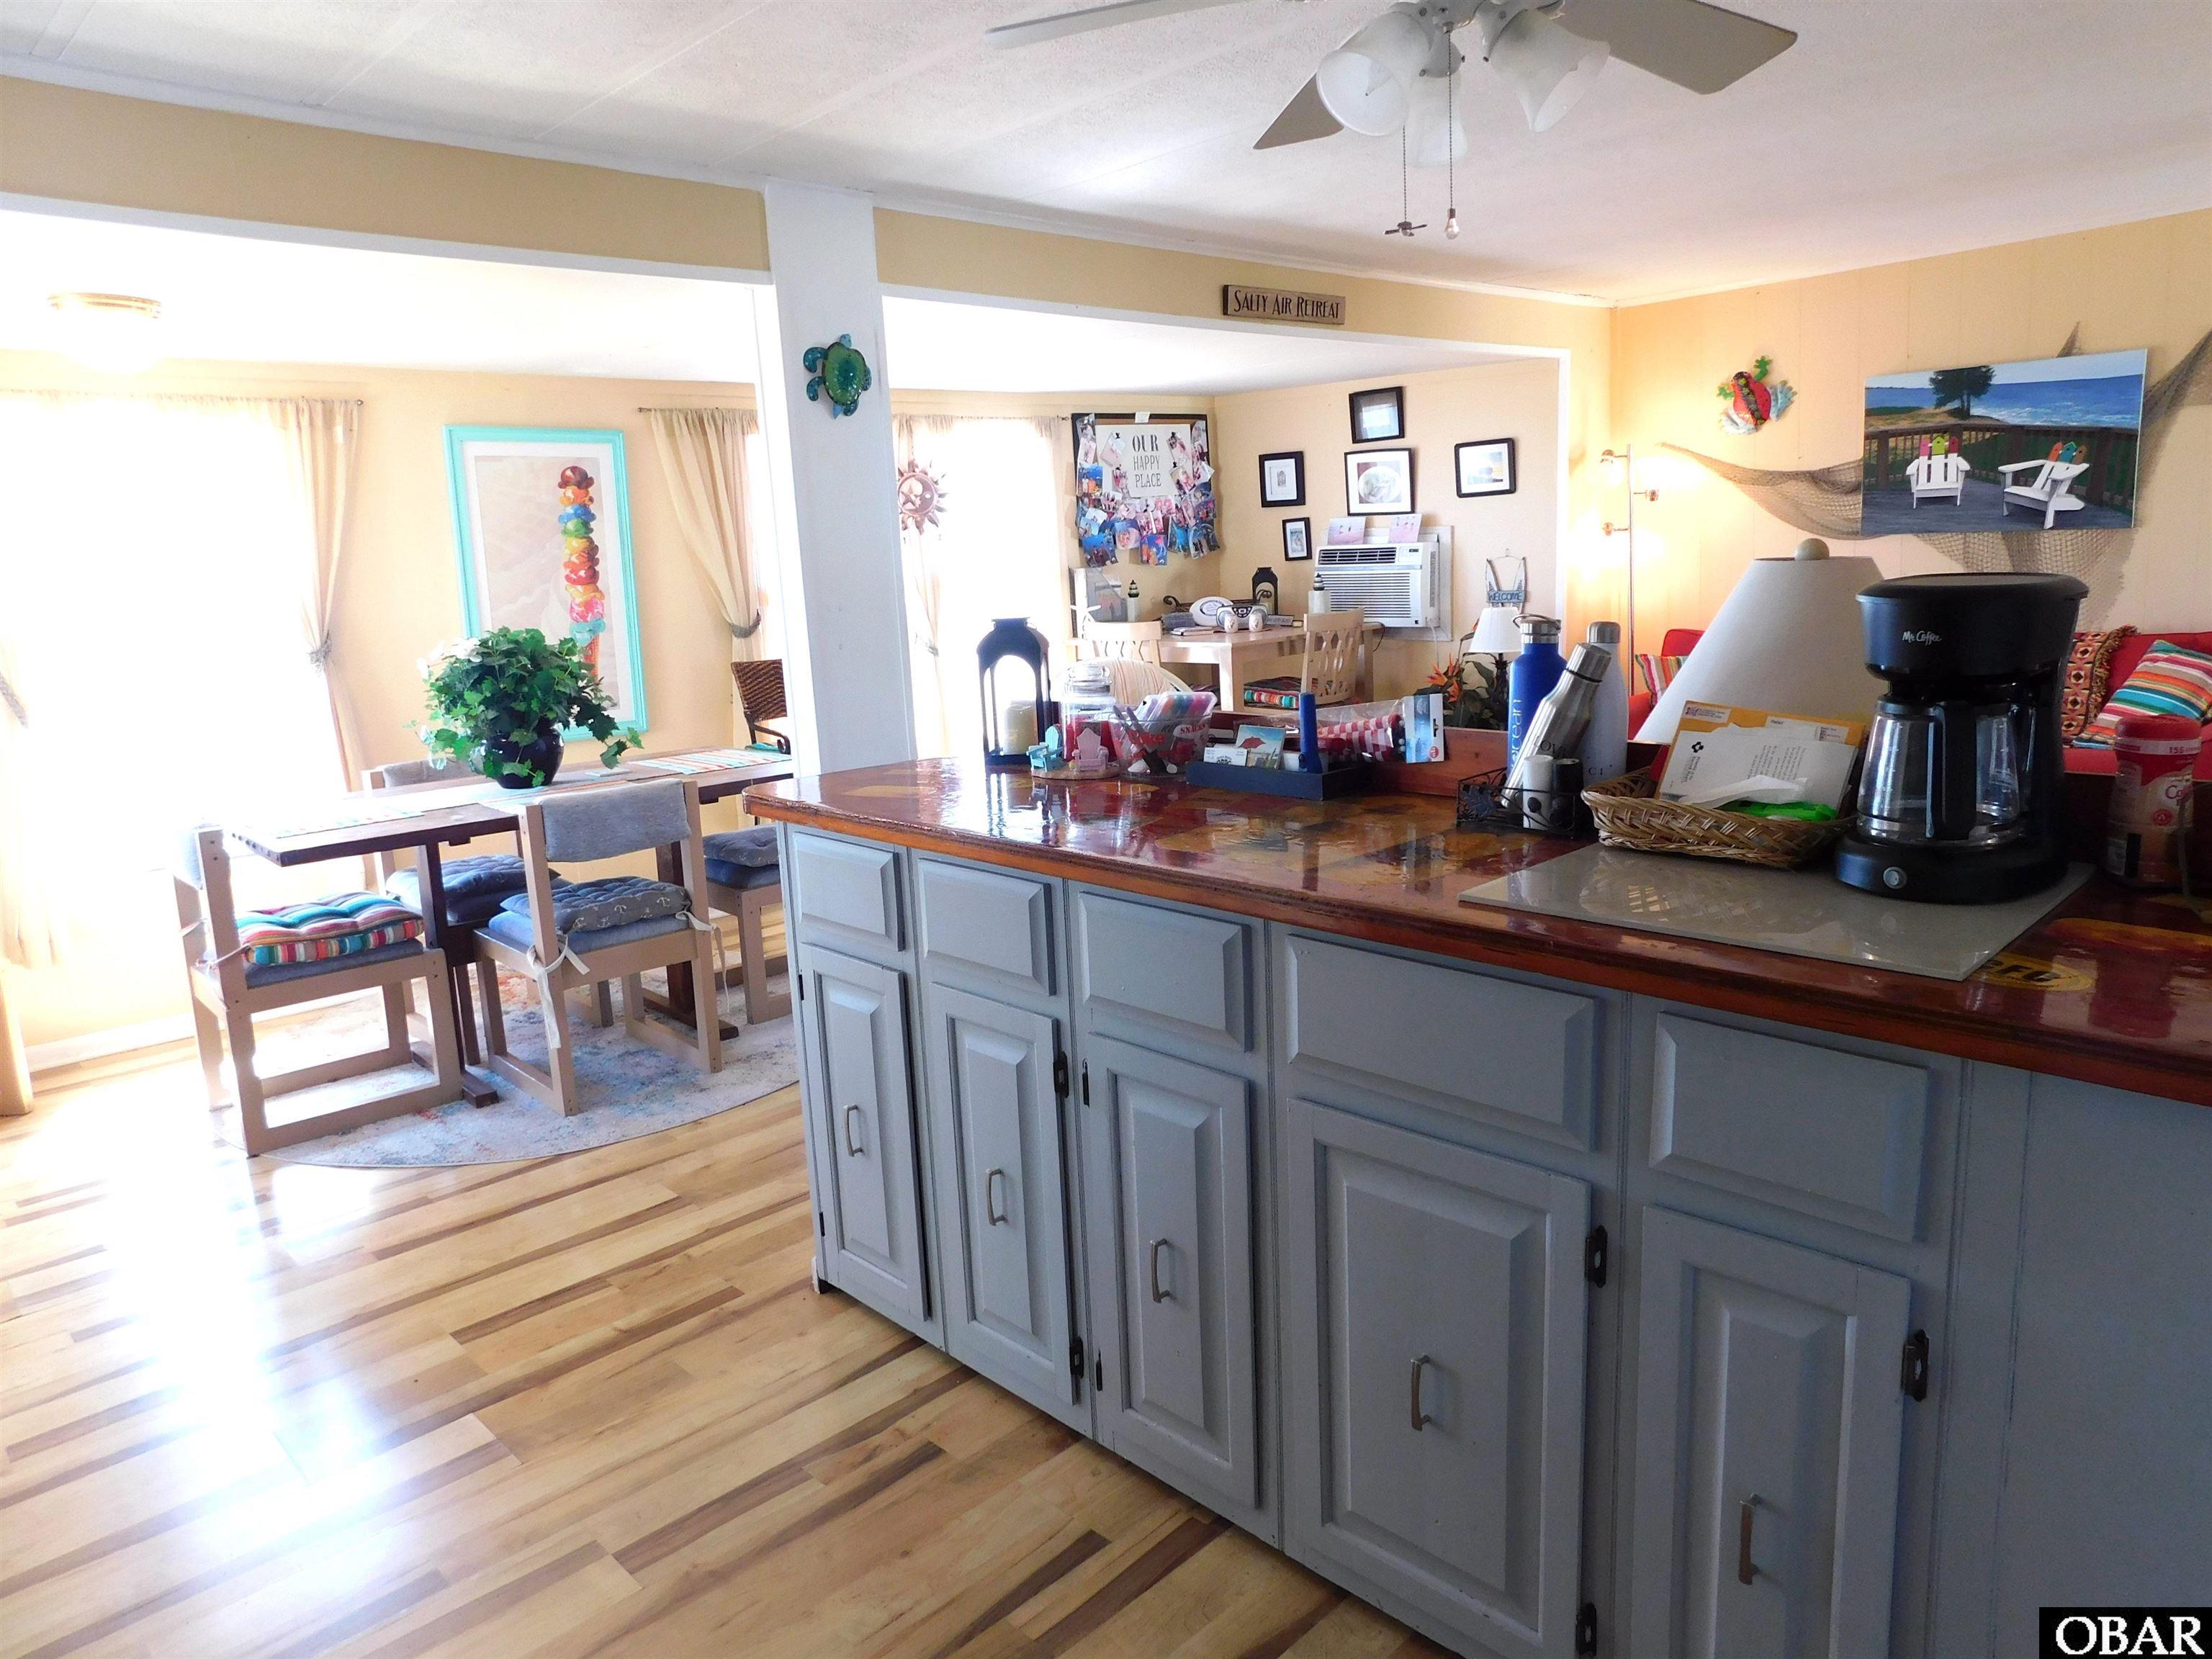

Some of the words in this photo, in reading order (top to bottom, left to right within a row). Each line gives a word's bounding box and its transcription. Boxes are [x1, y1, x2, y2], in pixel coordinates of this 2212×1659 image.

[1132, 434, 1159, 452] OUR
[1133, 454, 1161, 471] HAPPY
[1135, 473, 1162, 488] PLACE
[1488, 591, 1524, 601] WELCOME
[1916, 630, 1943, 646] Coffee
